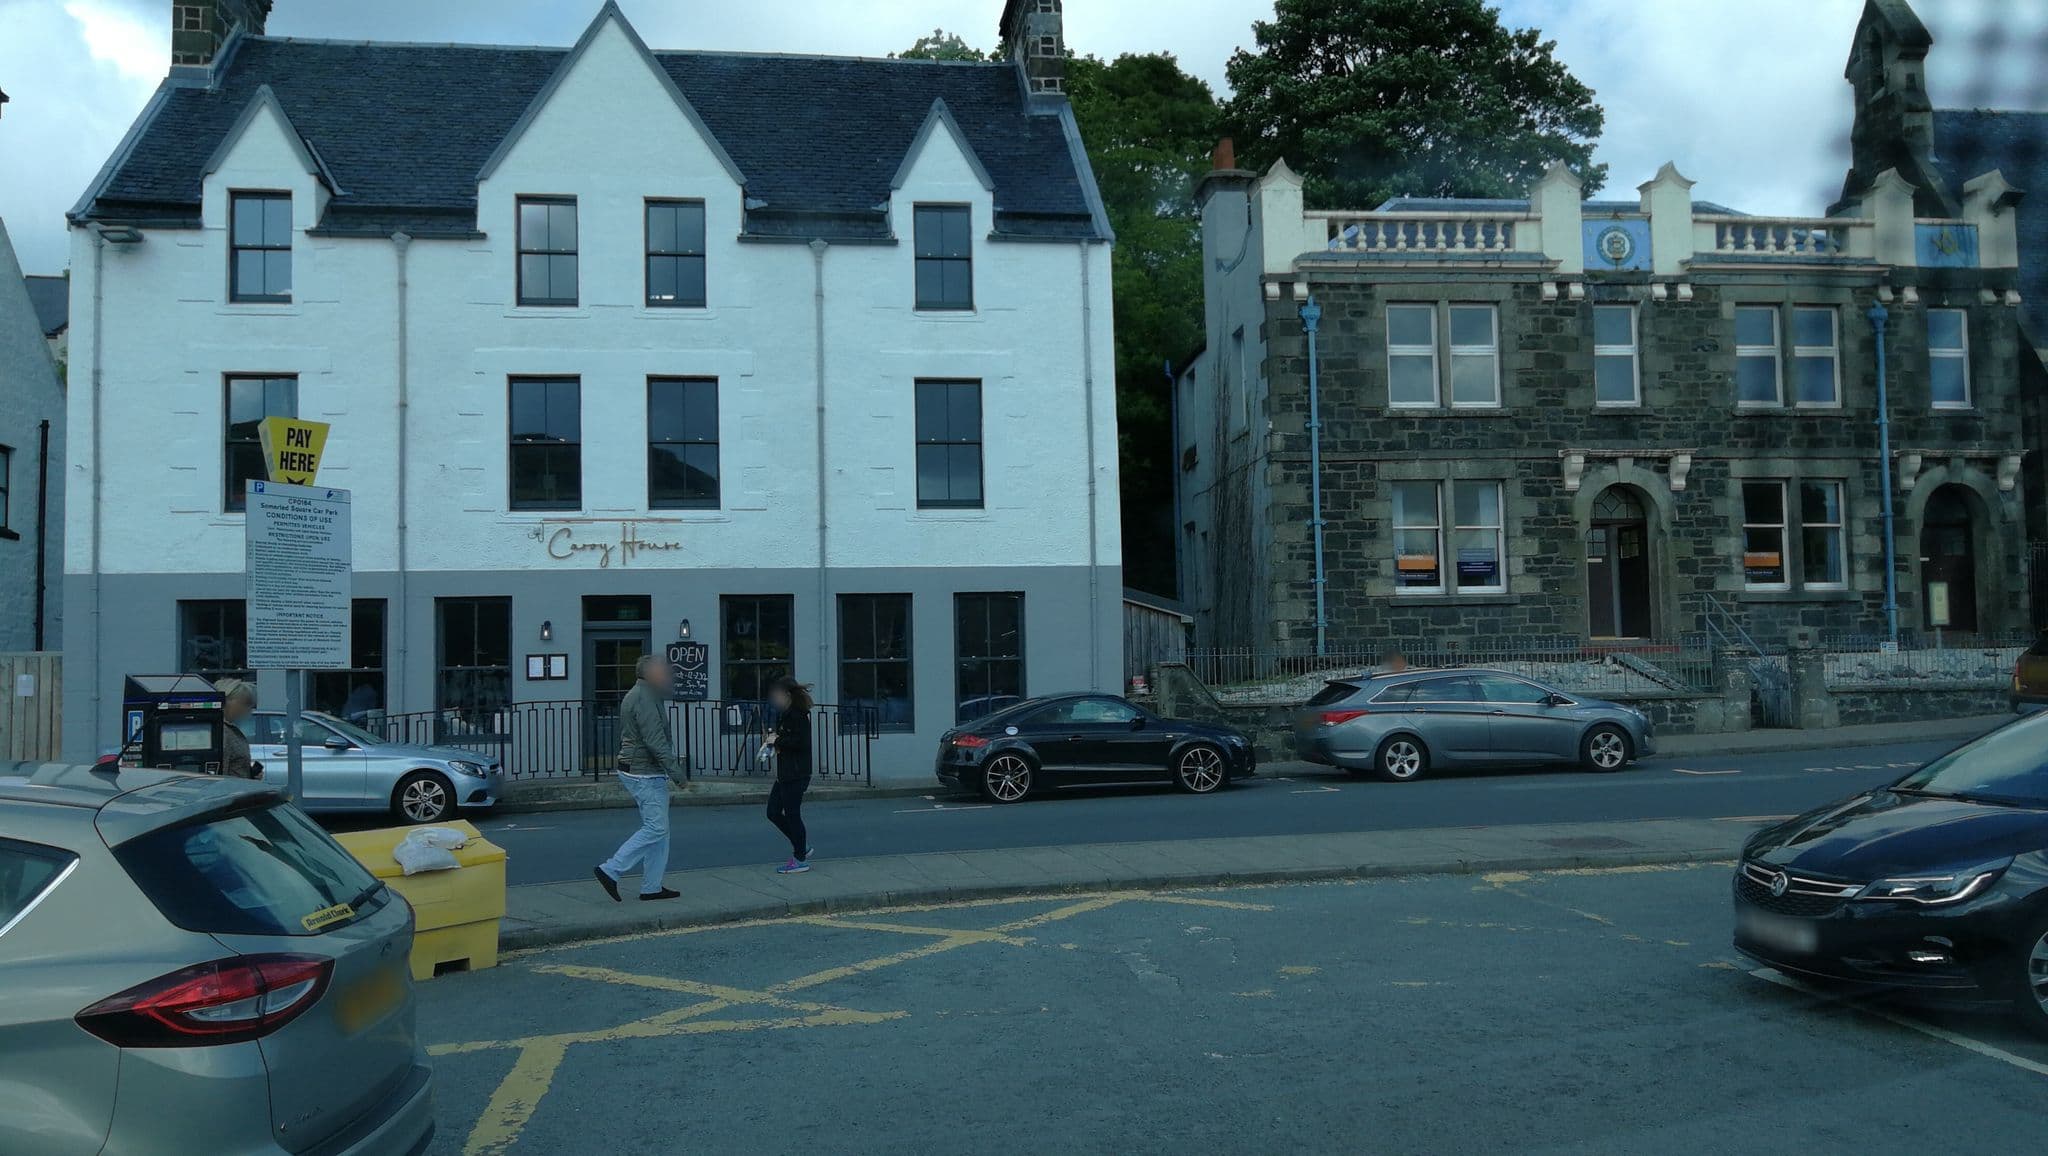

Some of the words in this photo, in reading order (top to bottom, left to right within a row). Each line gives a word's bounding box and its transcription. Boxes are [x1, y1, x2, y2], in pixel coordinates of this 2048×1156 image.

[286, 427, 312, 448] PAY
[279, 451, 315, 472] HERE
[266, 511, 308, 521] CONDITIONS
[291, 505, 311, 513] Square
[325, 508, 338, 516] Park
[620, 522, 684, 566] House
[670, 646, 705, 663] OPEN
[306, 911, 331, 926] Arnold
